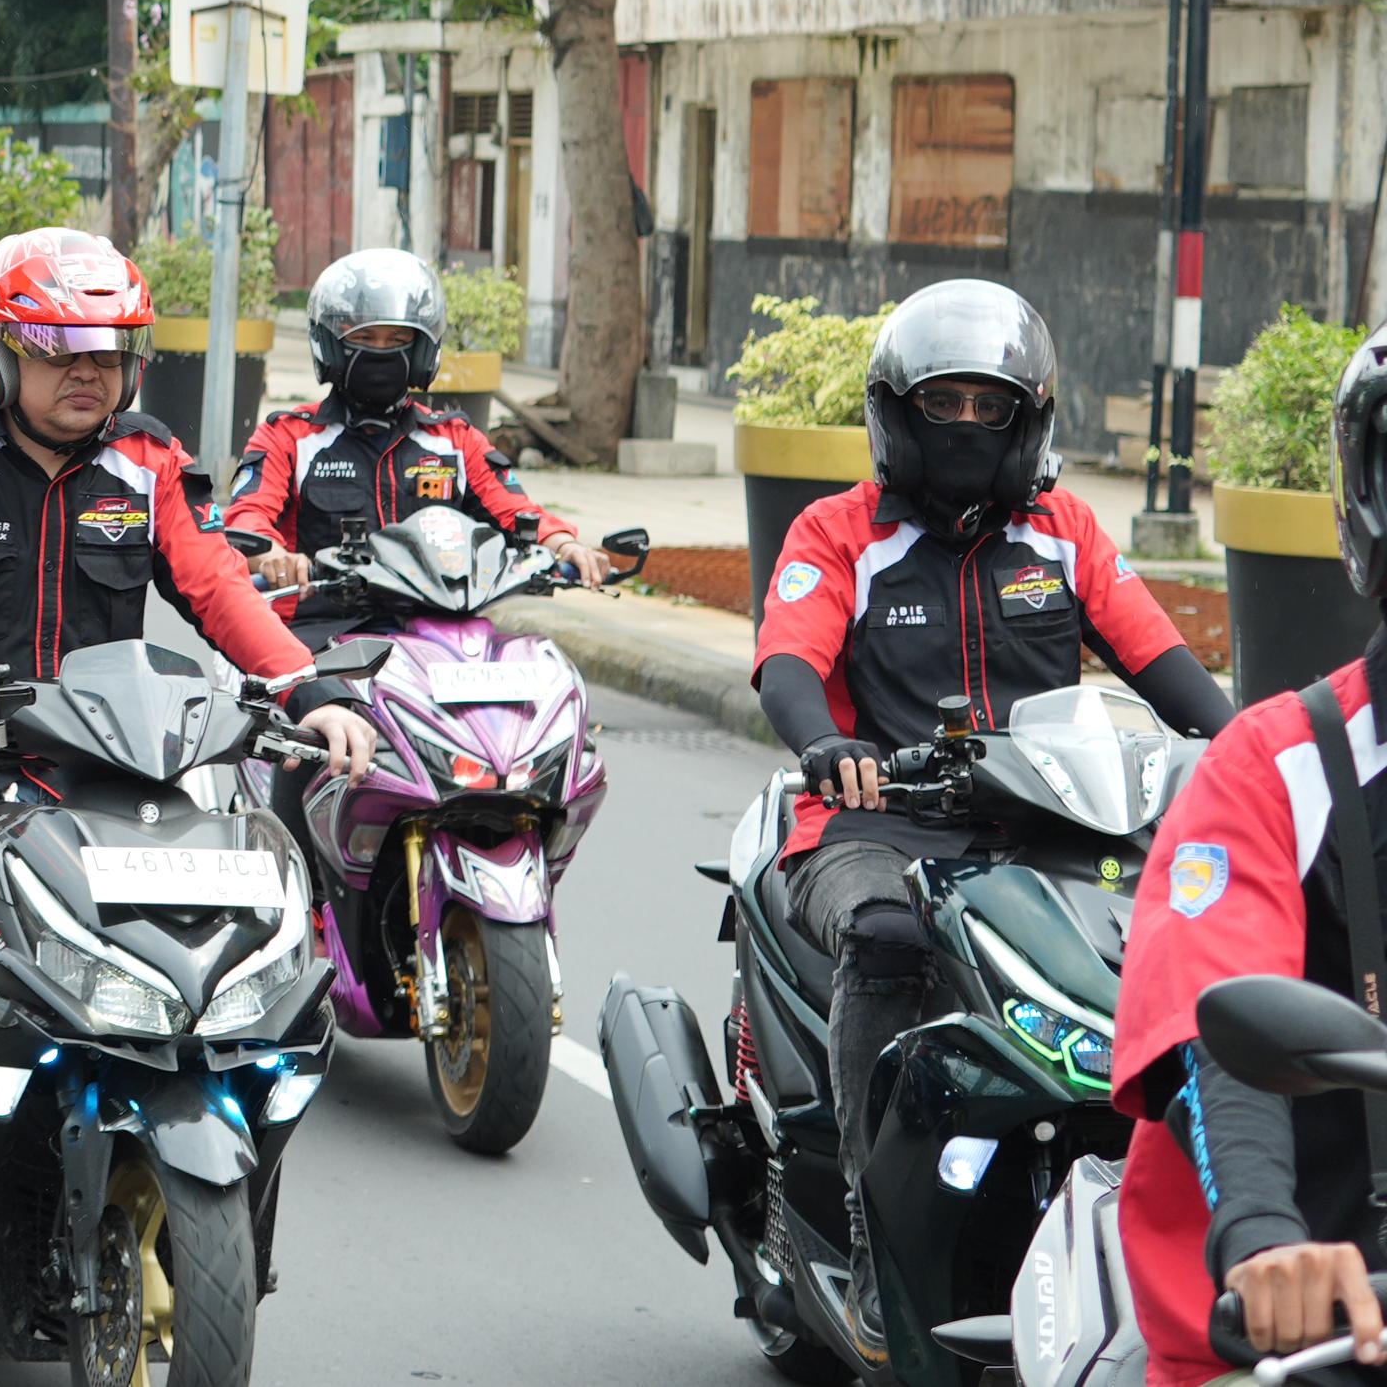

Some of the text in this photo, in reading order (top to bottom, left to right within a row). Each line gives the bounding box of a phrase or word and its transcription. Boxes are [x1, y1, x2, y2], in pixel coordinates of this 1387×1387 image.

[889, 604, 924, 616] ABIE
[92, 850, 269, 876] L 4613 ACJ
[1034, 1251, 1056, 1361] aerox
